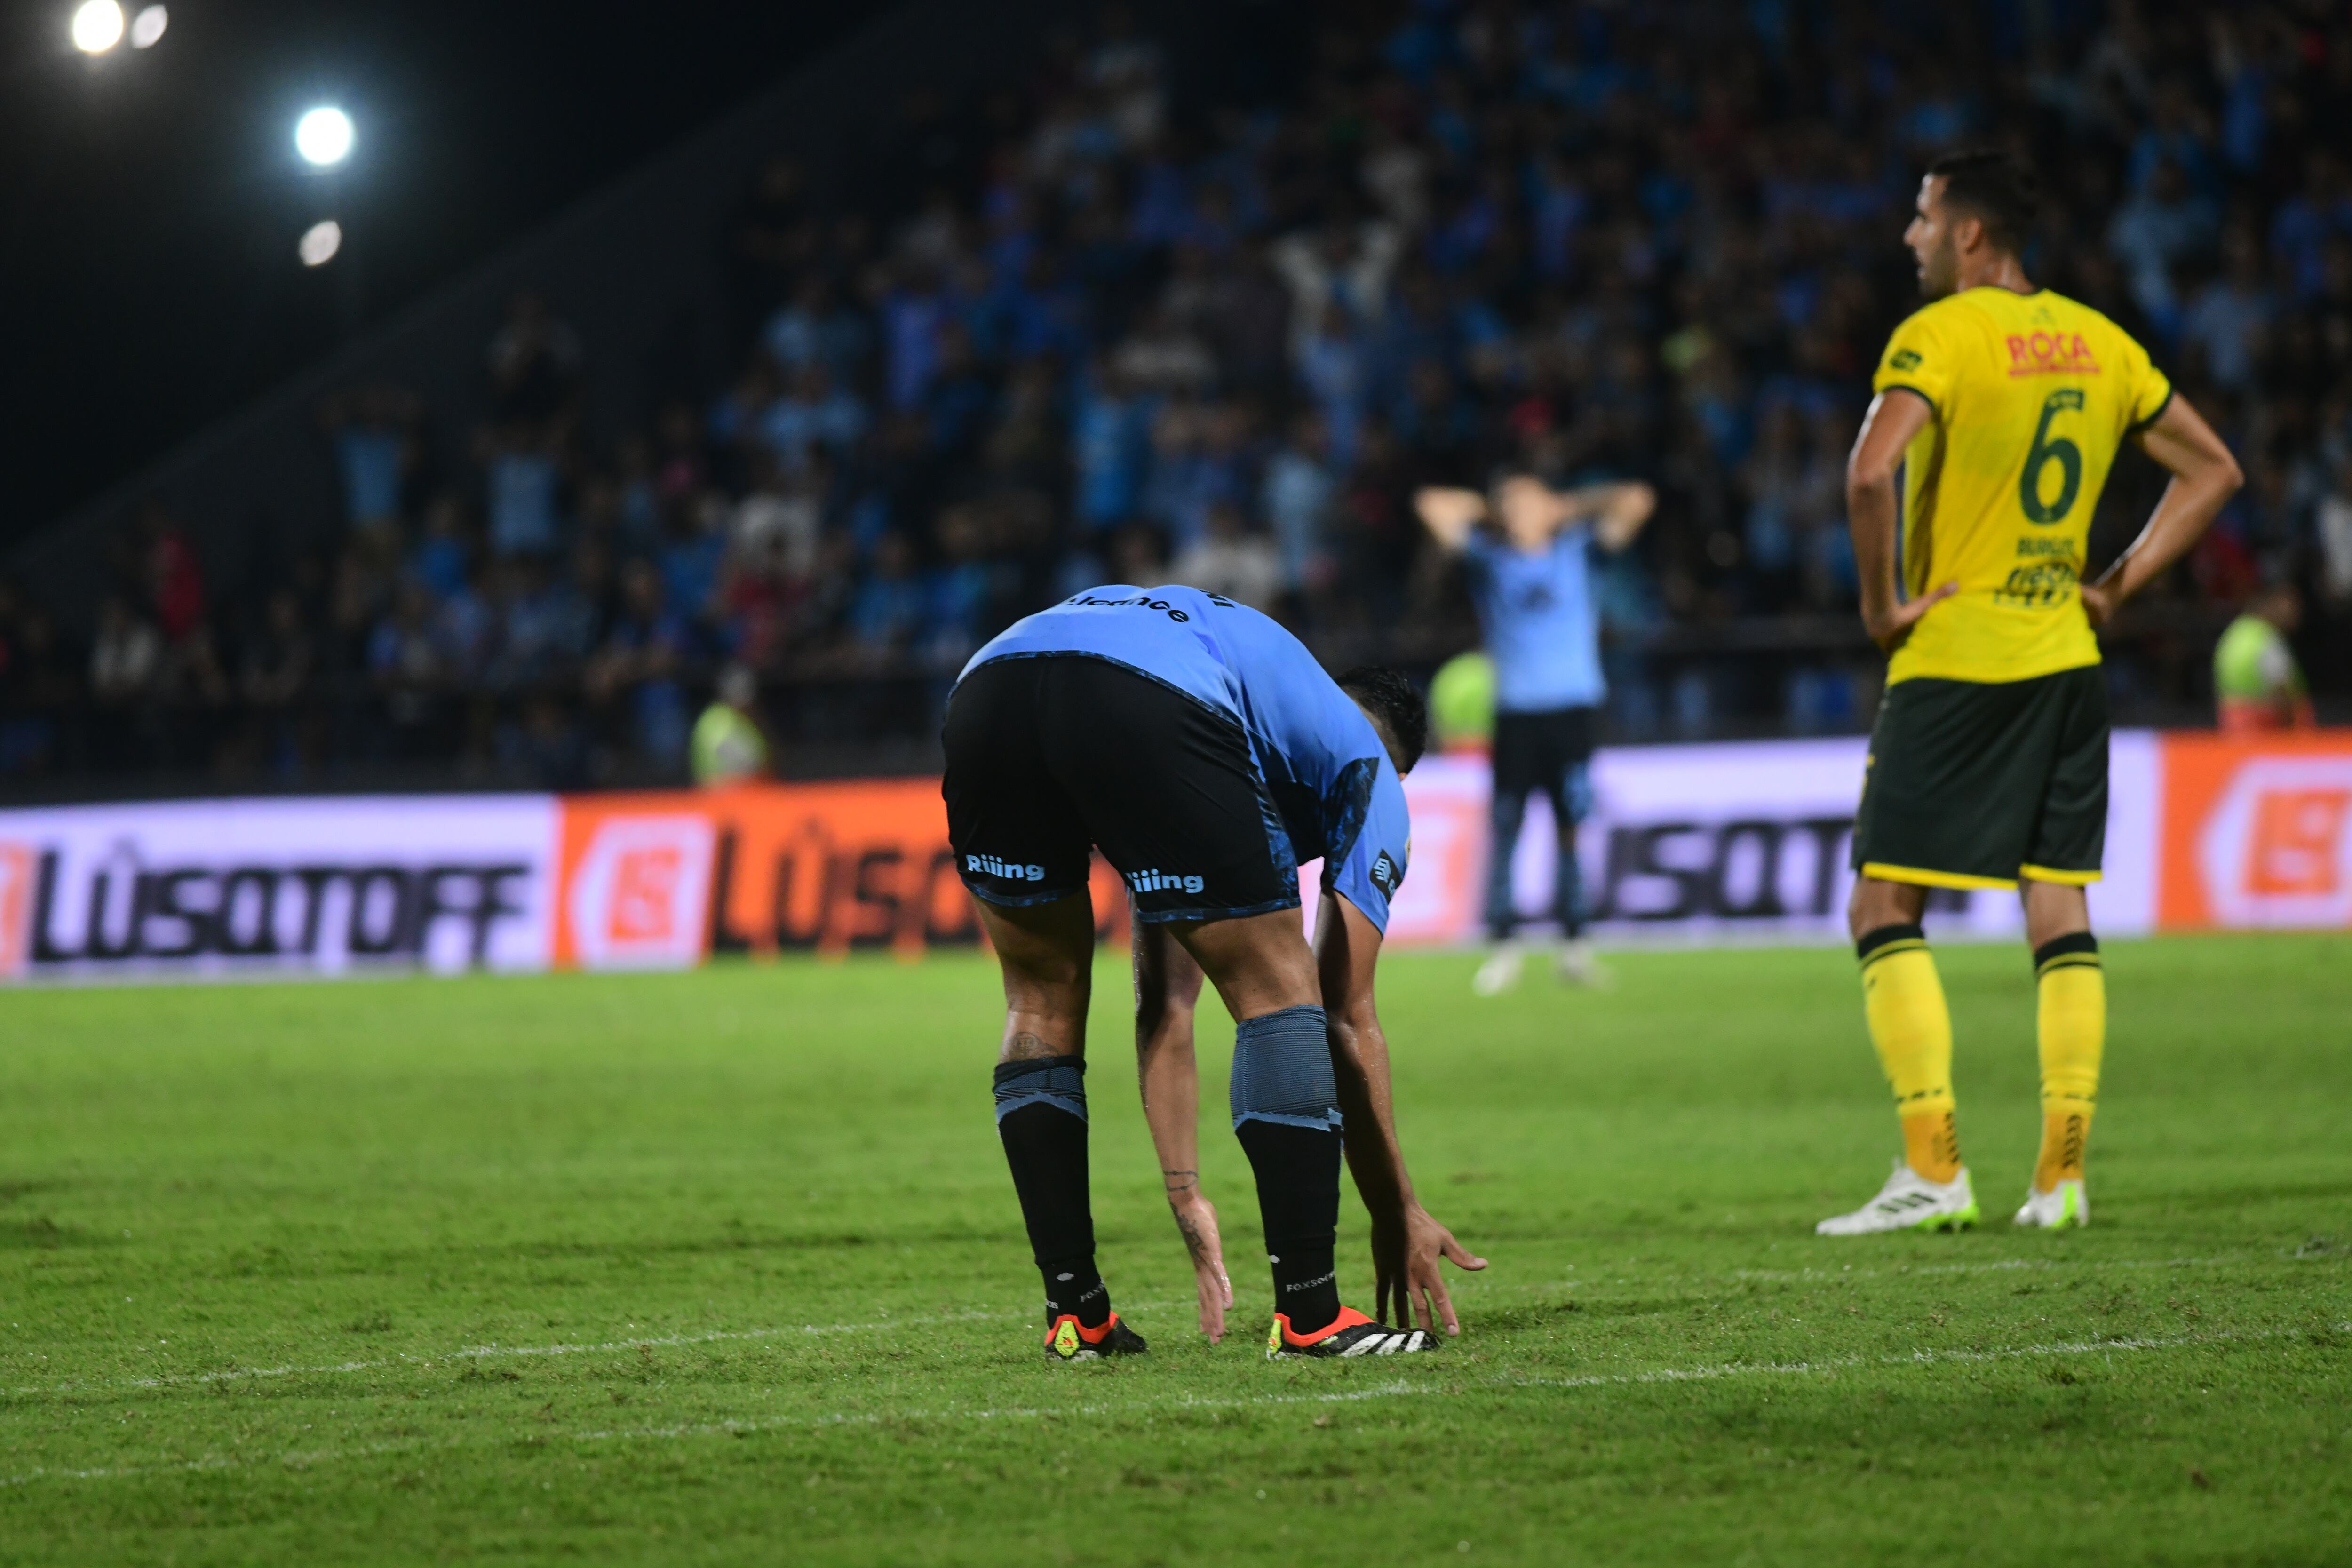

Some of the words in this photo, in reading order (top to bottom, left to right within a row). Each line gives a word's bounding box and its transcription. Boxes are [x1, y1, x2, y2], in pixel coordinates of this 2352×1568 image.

[2006, 330, 2095, 363] ROCA
[2019, 388, 2085, 526] 6
[966, 854, 1045, 881] Riiing
[1125, 868, 1204, 893] iiing
